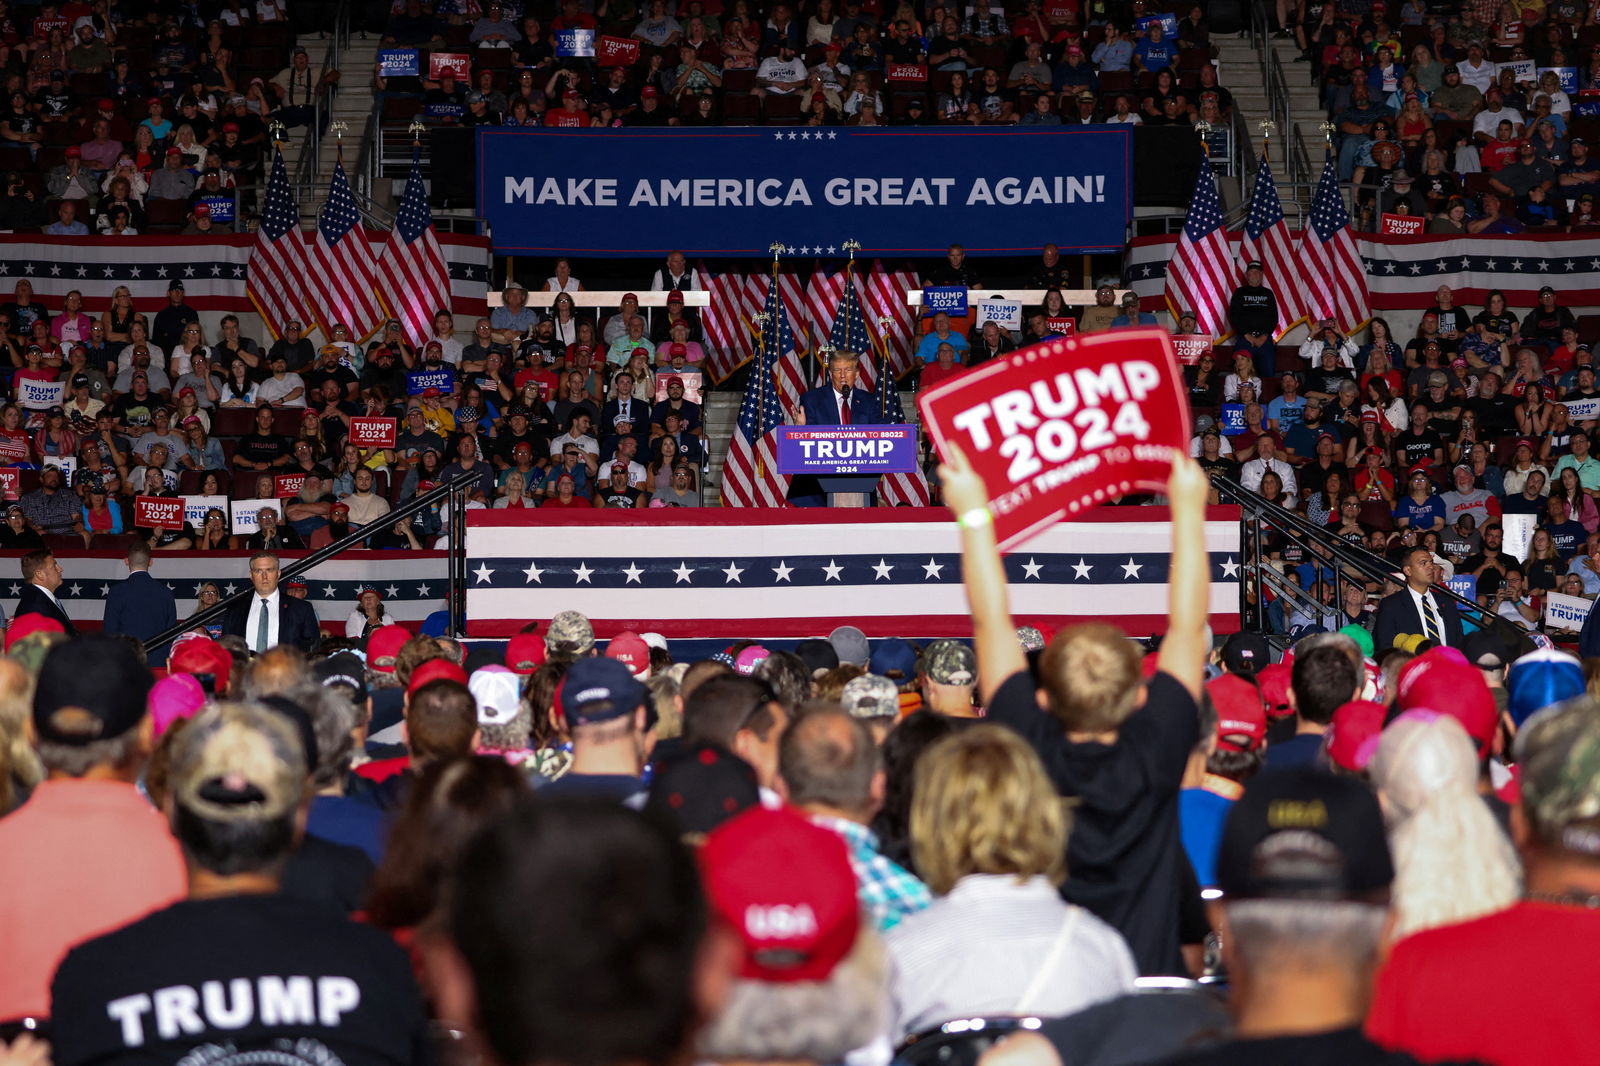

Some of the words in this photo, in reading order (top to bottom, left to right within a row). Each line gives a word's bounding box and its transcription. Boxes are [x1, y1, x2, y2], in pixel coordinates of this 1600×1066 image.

[605, 39, 636, 50] TRUMP
[387, 60, 411, 68] 2024
[434, 58, 466, 66] TRUMP
[505, 176, 617, 206] MAKE
[629, 178, 813, 207] AMERICA
[824, 177, 955, 206] GREAT
[966, 175, 1106, 205] AGAIN!
[1385, 218, 1421, 230] TRUMP
[1389, 226, 1416, 235] 2024
[927, 291, 964, 300] TRUMP
[932, 299, 959, 307] 2024
[982, 304, 1019, 313] TRUMP
[986, 312, 1012, 321] 2024
[1172, 340, 1209, 349] TRUMP
[1177, 348, 1203, 356] 2024
[410, 374, 448, 383] TRUMP
[24, 384, 61, 394] TRUMP
[28, 393, 55, 401] 2024
[952, 360, 1162, 452] TRUMP
[1568, 403, 1597, 411] RUMP
[354, 422, 392, 432] TRUMP
[359, 430, 386, 439] 2024
[998, 401, 1151, 483] 2024
[799, 440, 894, 458] TRUMP
[1406, 443, 1431, 451] George
[140, 501, 181, 513] TRUMP
[145, 511, 175, 520] 2024
[1442, 542, 1471, 553] TRUMP
[1446, 581, 1471, 590] UMP
[1555, 603, 1574, 611] STAND
[108, 975, 361, 1047] TRUMP
